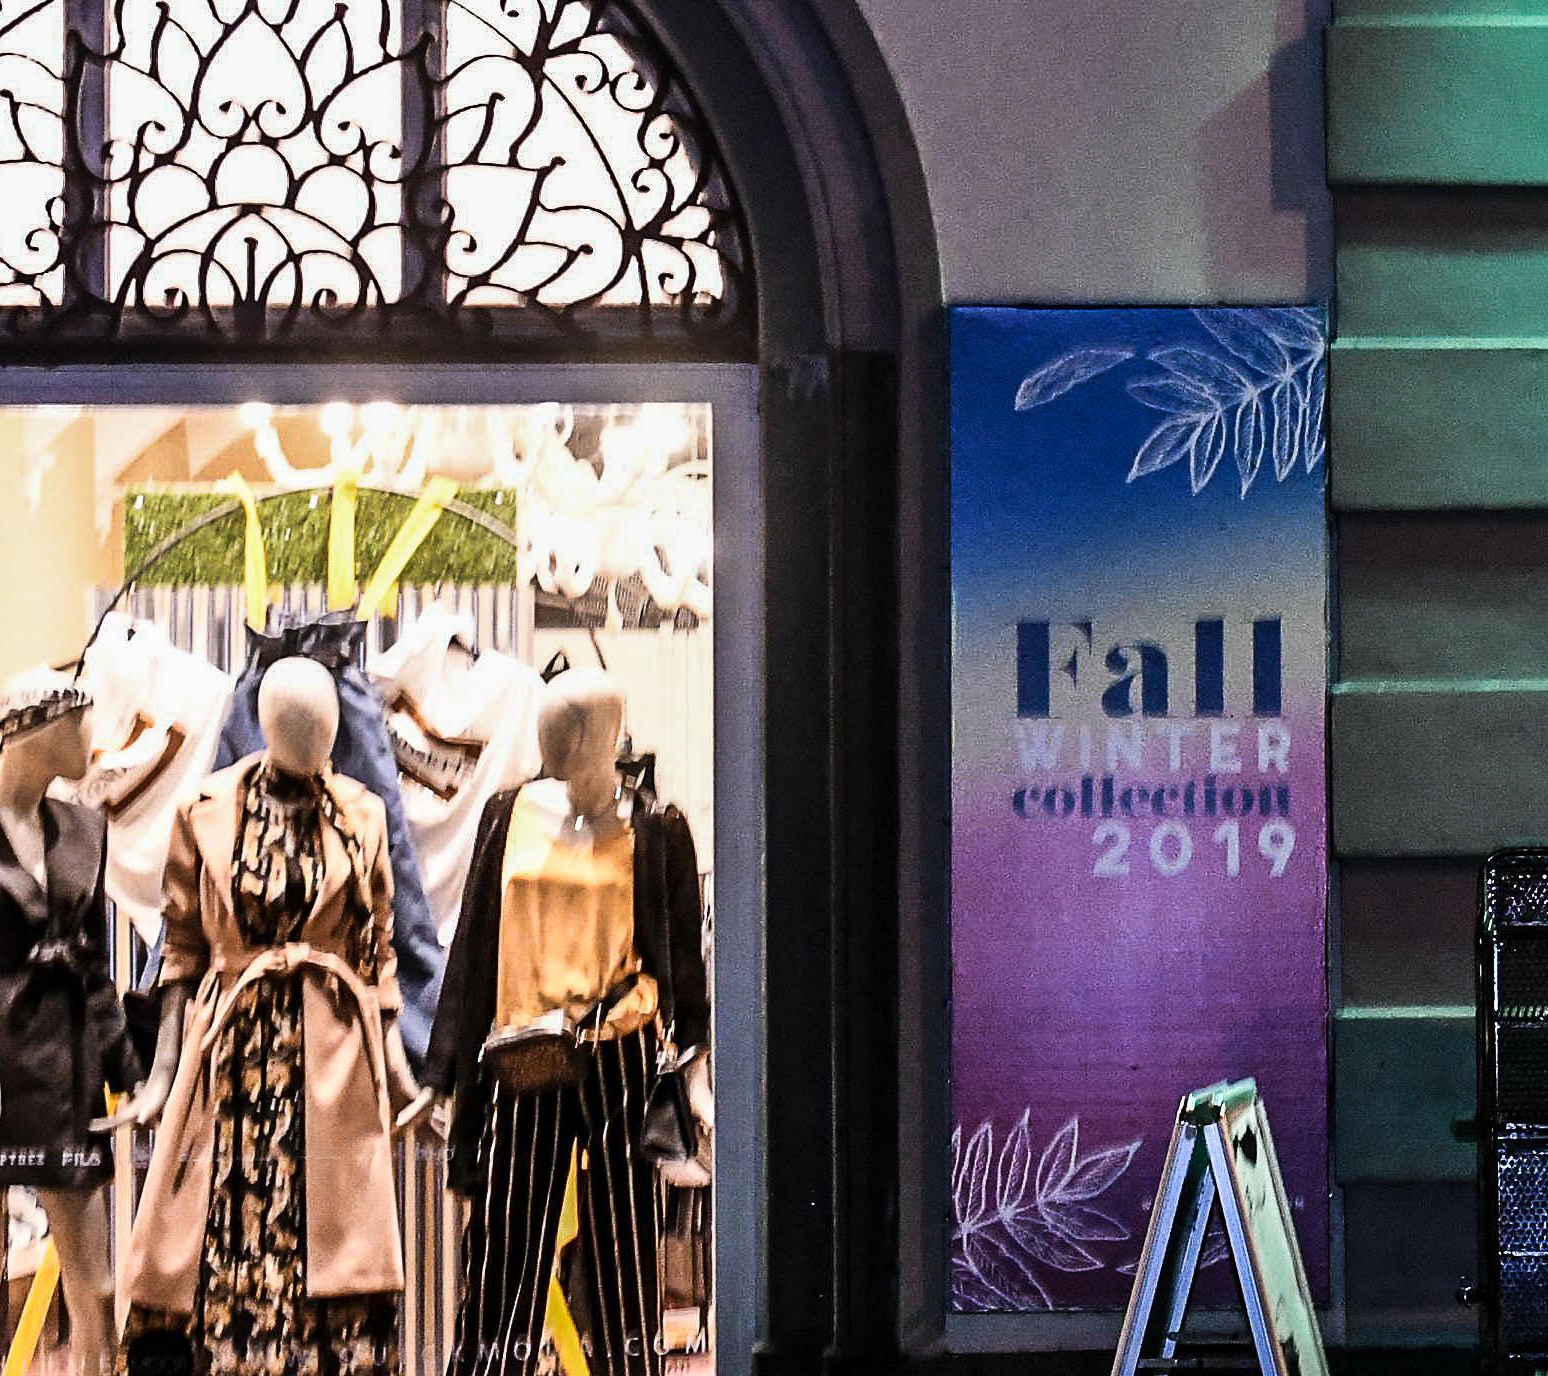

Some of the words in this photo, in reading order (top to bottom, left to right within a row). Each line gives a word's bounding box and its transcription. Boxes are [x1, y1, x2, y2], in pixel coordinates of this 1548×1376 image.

[1016, 617, 1283, 719] Fall
[1013, 723, 1292, 773] WINTER
[1013, 775, 1290, 818] collection
[1092, 820, 1297, 877] 2019
